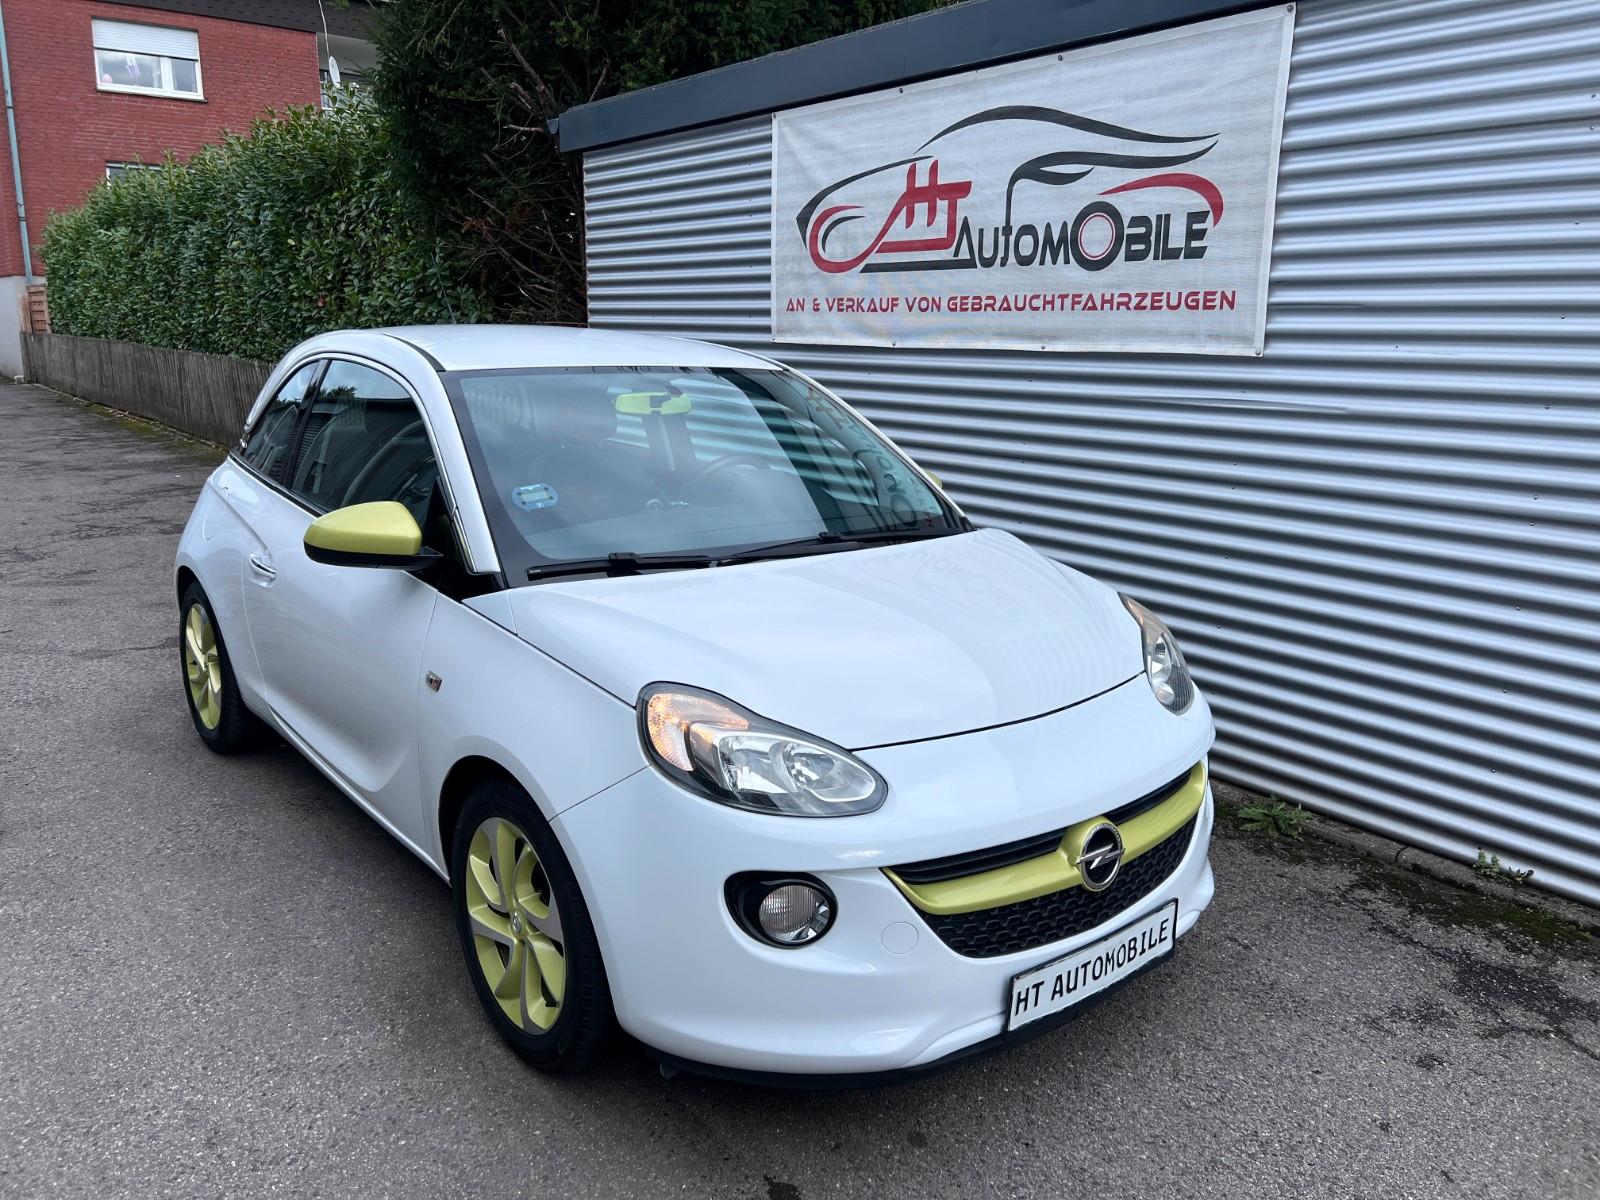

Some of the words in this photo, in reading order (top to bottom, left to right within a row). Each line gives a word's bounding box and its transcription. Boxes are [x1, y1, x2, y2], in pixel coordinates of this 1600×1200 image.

[888, 159, 972, 253] HT
[786, 297, 805, 312] AN
[812, 298, 821, 312] &
[825, 297, 899, 313] VERKAUF
[905, 296, 941, 313] VON
[947, 290, 1236, 312] GEBRAUCHTFAHRZEUGEN
[1015, 980, 1045, 1016] HT
[1051, 918, 1169, 1001] AUTOMOBILE
